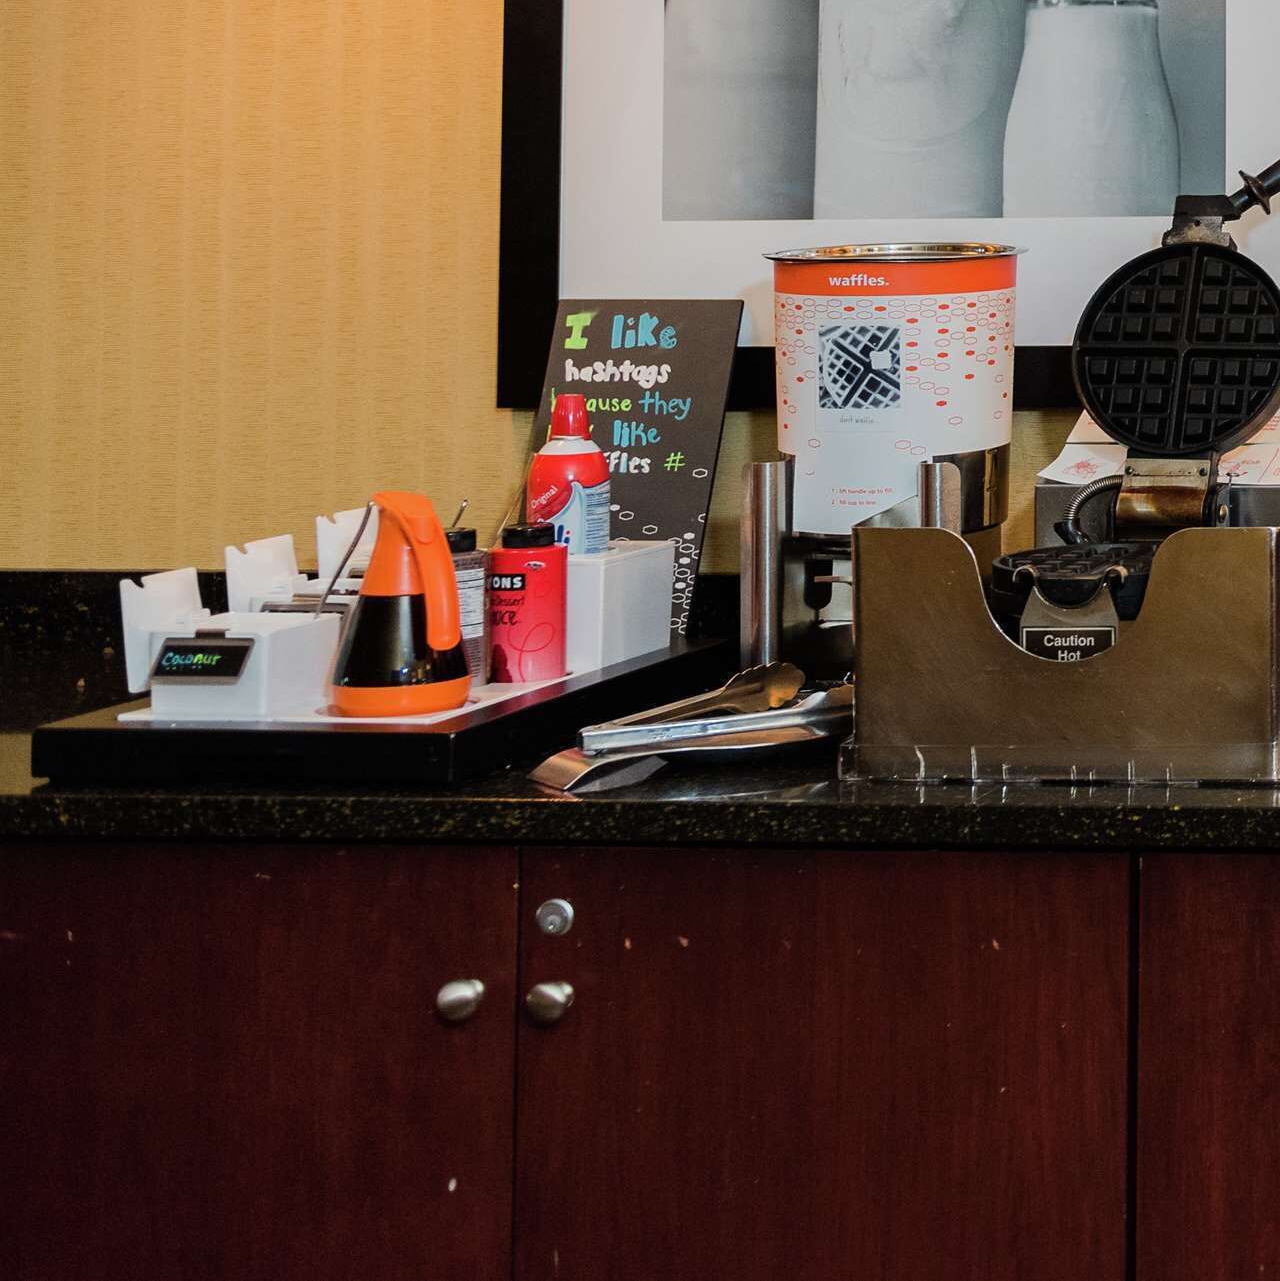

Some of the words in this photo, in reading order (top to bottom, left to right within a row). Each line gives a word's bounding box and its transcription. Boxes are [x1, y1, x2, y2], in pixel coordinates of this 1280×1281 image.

[828, 273, 889, 287] waffles.
[564, 312, 595, 350] I
[610, 312, 678, 350] like
[564, 358, 672, 389] hashtags
[551, 388, 632, 413] ause
[638, 390, 692, 421] they
[612, 419, 662, 448] like
[531, 485, 559, 509] Original
[490, 576, 523, 589] ONS
[1043, 634, 1095, 647] Caution
[1057, 650, 1081, 662] Hot
